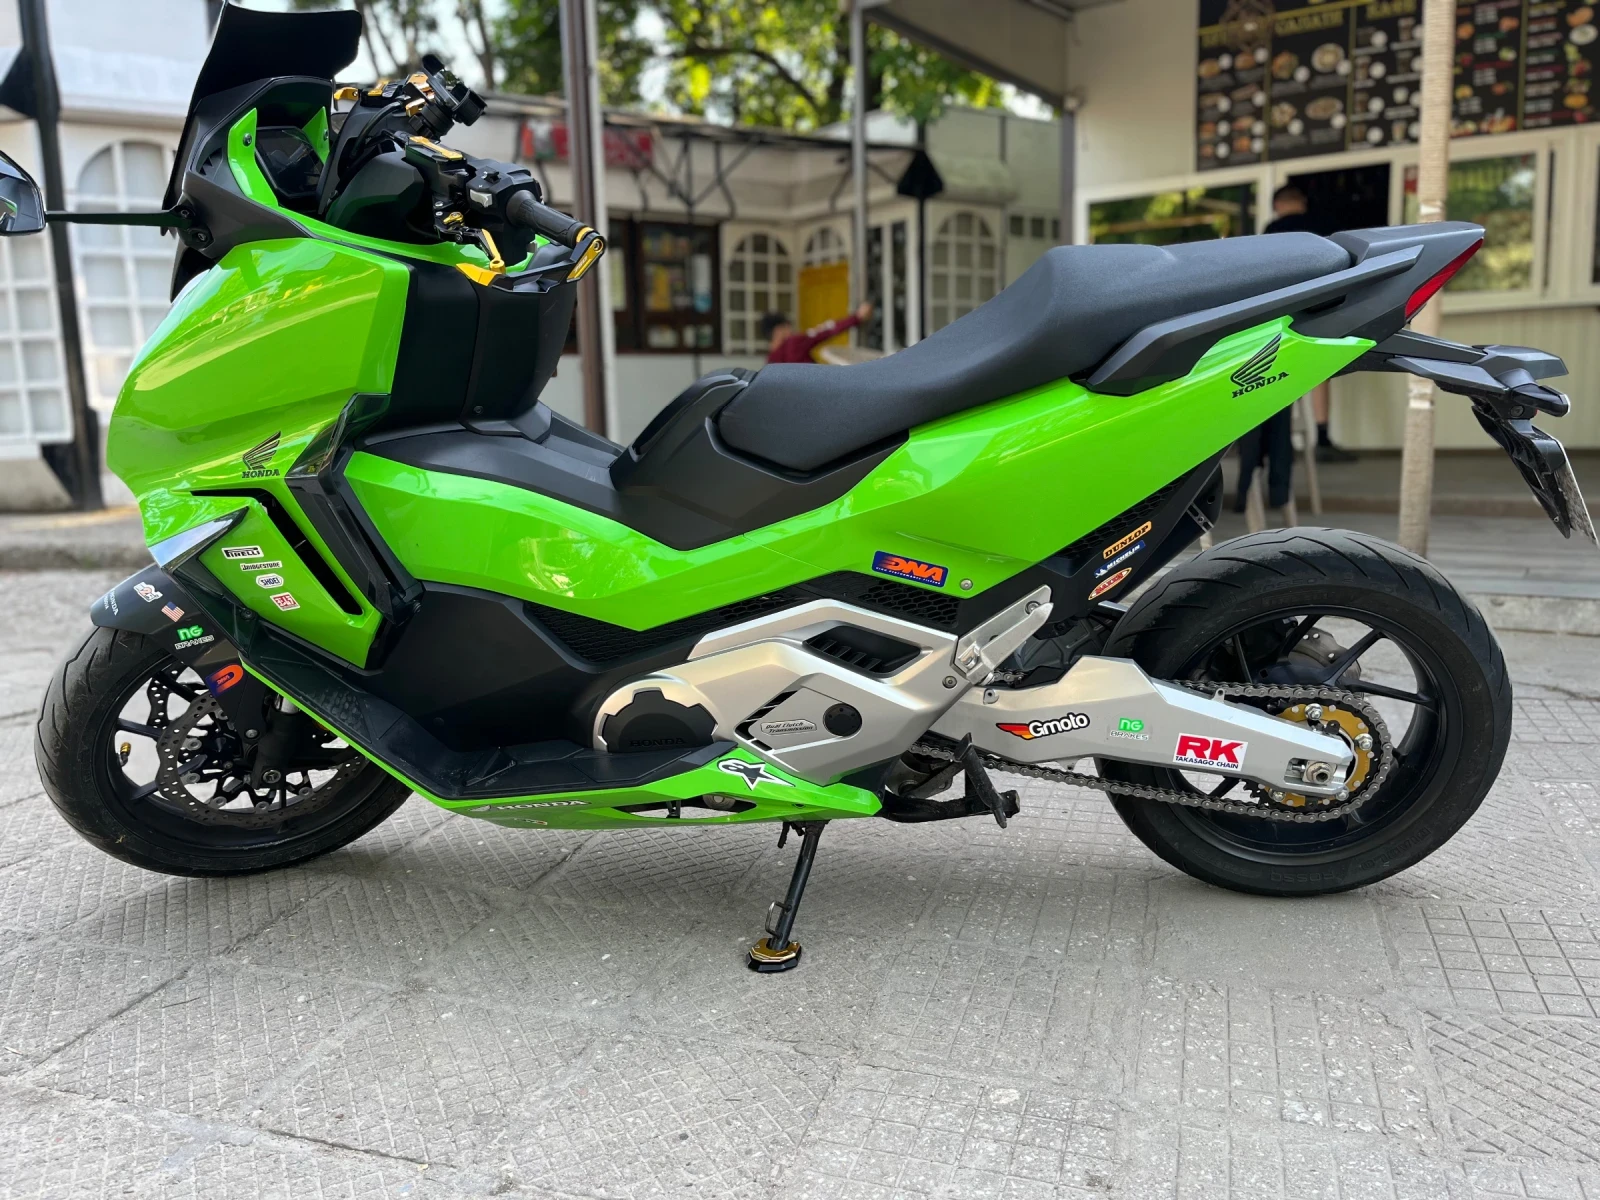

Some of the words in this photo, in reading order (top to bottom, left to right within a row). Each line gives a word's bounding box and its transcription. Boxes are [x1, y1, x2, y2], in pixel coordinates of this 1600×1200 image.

[1231, 371, 1290, 399] HONDA
[241, 469, 281, 479] HONDA
[1104, 525, 1149, 557] DUNLOP
[223, 547, 261, 558] PIRELLI
[1106, 544, 1141, 571] MICHELIN
[885, 557, 943, 581] DNA
[260, 577, 281, 586] SHOEI
[1029, 714, 1089, 737] Gmoto
[630, 738, 686, 747] HONDA
[1109, 730, 1149, 741] BRAKES
[1176, 735, 1243, 763] RK
[1175, 755, 1215, 766] TAKASAGO
[1216, 761, 1239, 769] CHAIN
[497, 800, 588, 810] HONDA
